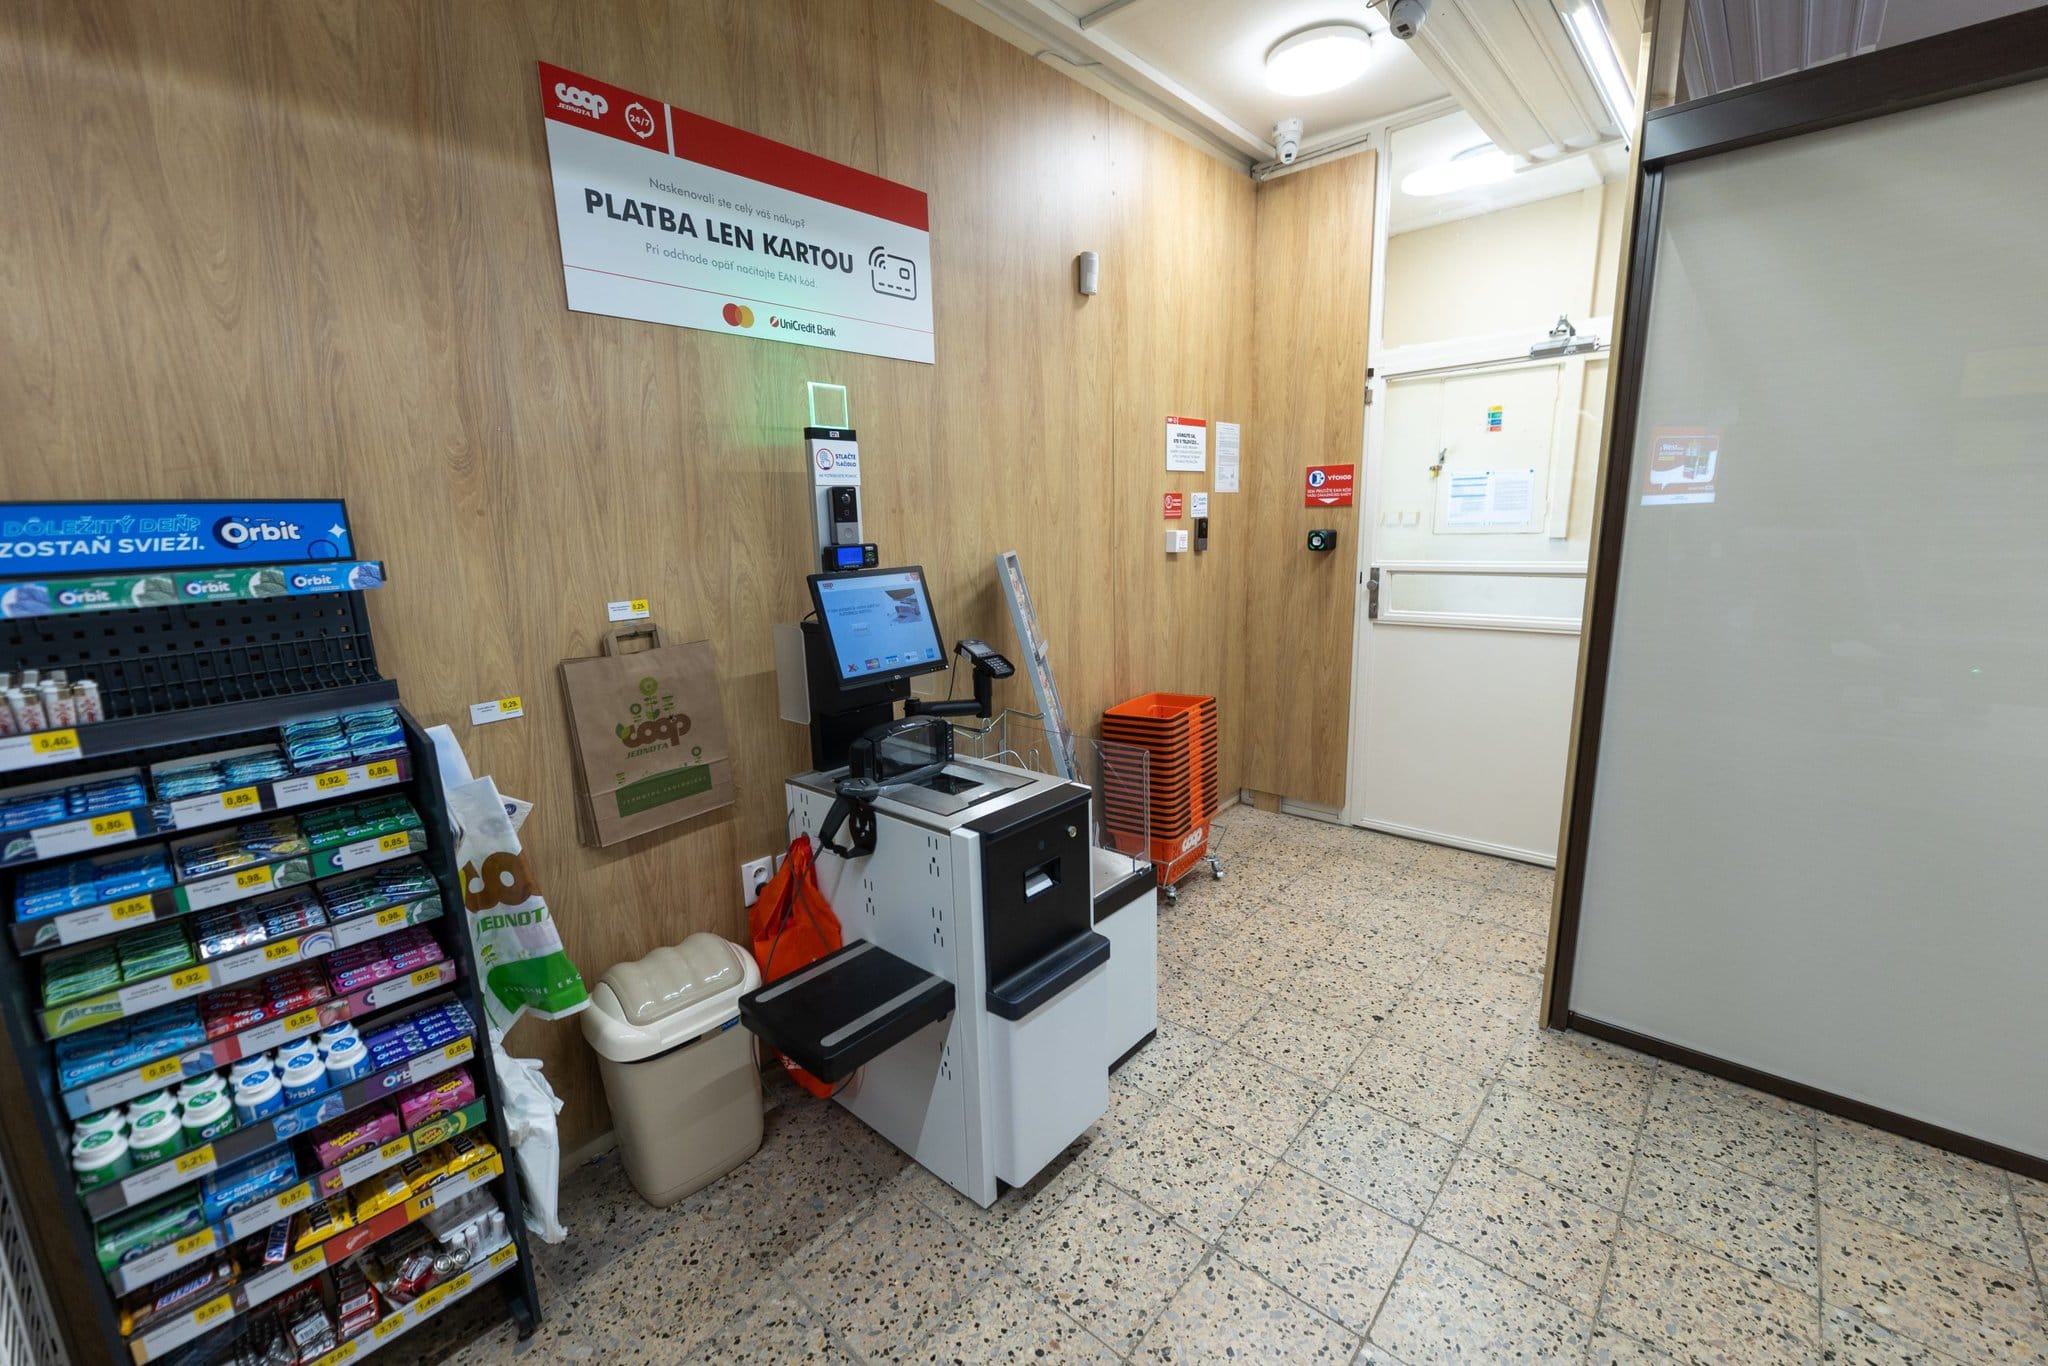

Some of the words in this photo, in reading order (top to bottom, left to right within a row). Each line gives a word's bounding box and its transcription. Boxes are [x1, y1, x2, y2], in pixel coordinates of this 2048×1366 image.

[555, 83, 608, 119] coop
[557, 102, 591, 117] JEDNOTA
[629, 114, 650, 127] 24/7
[649, 177, 716, 206] Naskenovali
[717, 197, 732, 209] ste
[734, 201, 754, 217] celý
[756, 205, 771, 220] váš
[773, 210, 806, 230] nákup?
[584, 188, 698, 239] PLATBA
[705, 218, 754, 252] LEN
[763, 232, 854, 274] KARTOU
[645, 242, 660, 255] Pri
[663, 246, 708, 265] odchode
[711, 256, 734, 272] opäť
[736, 260, 776, 281] načítajte
[778, 272, 798, 284] EAN
[780, 318, 815, 335] UniCredit
[817, 323, 836, 338] Bank
[3, 512, 135, 537] DÔLEŽITÝ
[139, 513, 201, 534] DEŇ?
[220, 517, 303, 546] Orbit
[0, 535, 111, 558] ZOSTAŇ
[117, 534, 205, 554] SVIEŽI.
[184, 578, 232, 597] Orbit
[293, 573, 332, 588] Orbit
[58, 588, 110, 607] Orbit
[476, 905, 551, 941] JEDNOT
[383, 1071, 411, 1087] Orb
